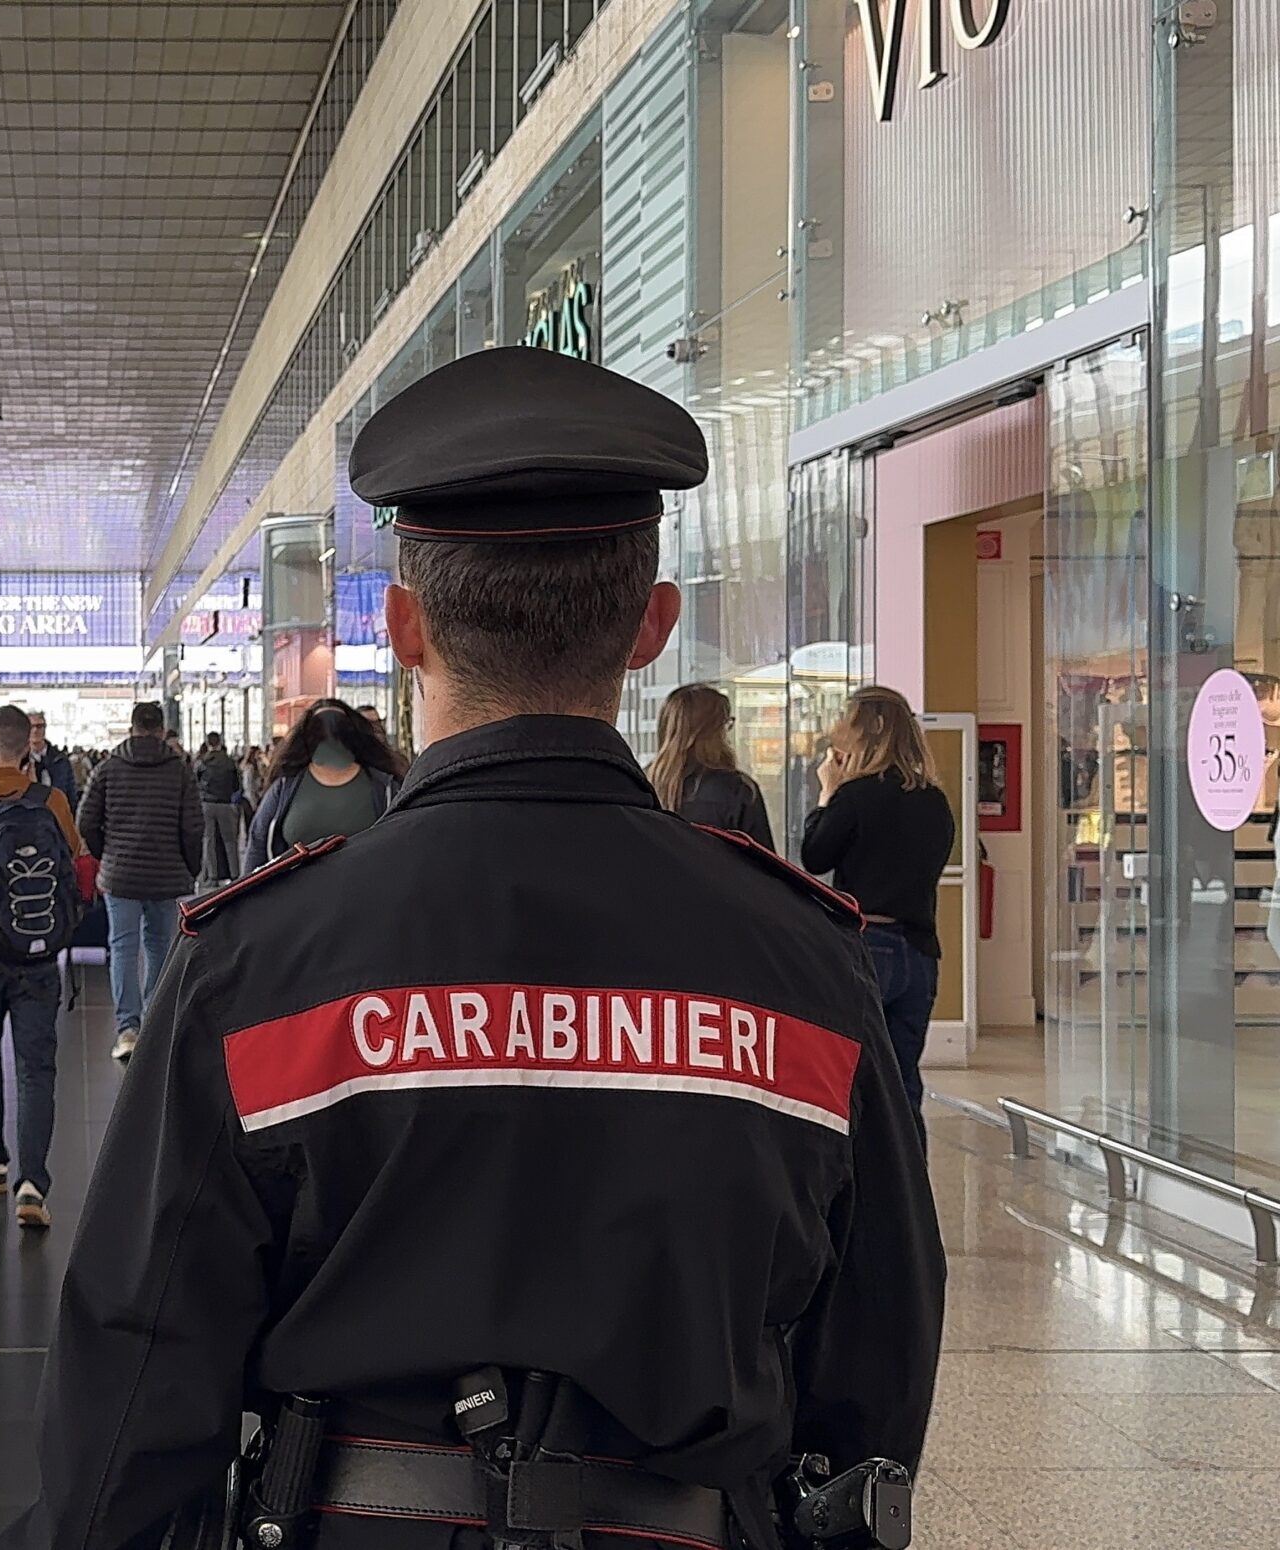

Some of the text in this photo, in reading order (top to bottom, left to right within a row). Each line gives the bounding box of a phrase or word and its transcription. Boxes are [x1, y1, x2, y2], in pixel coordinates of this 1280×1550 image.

[22, 595, 60, 611] THE
[61, 595, 104, 612] NEW
[20, 614, 88, 635] AREA
[1201, 733, 1251, 783] -35%
[352, 990, 777, 1081] CARABINIERI
